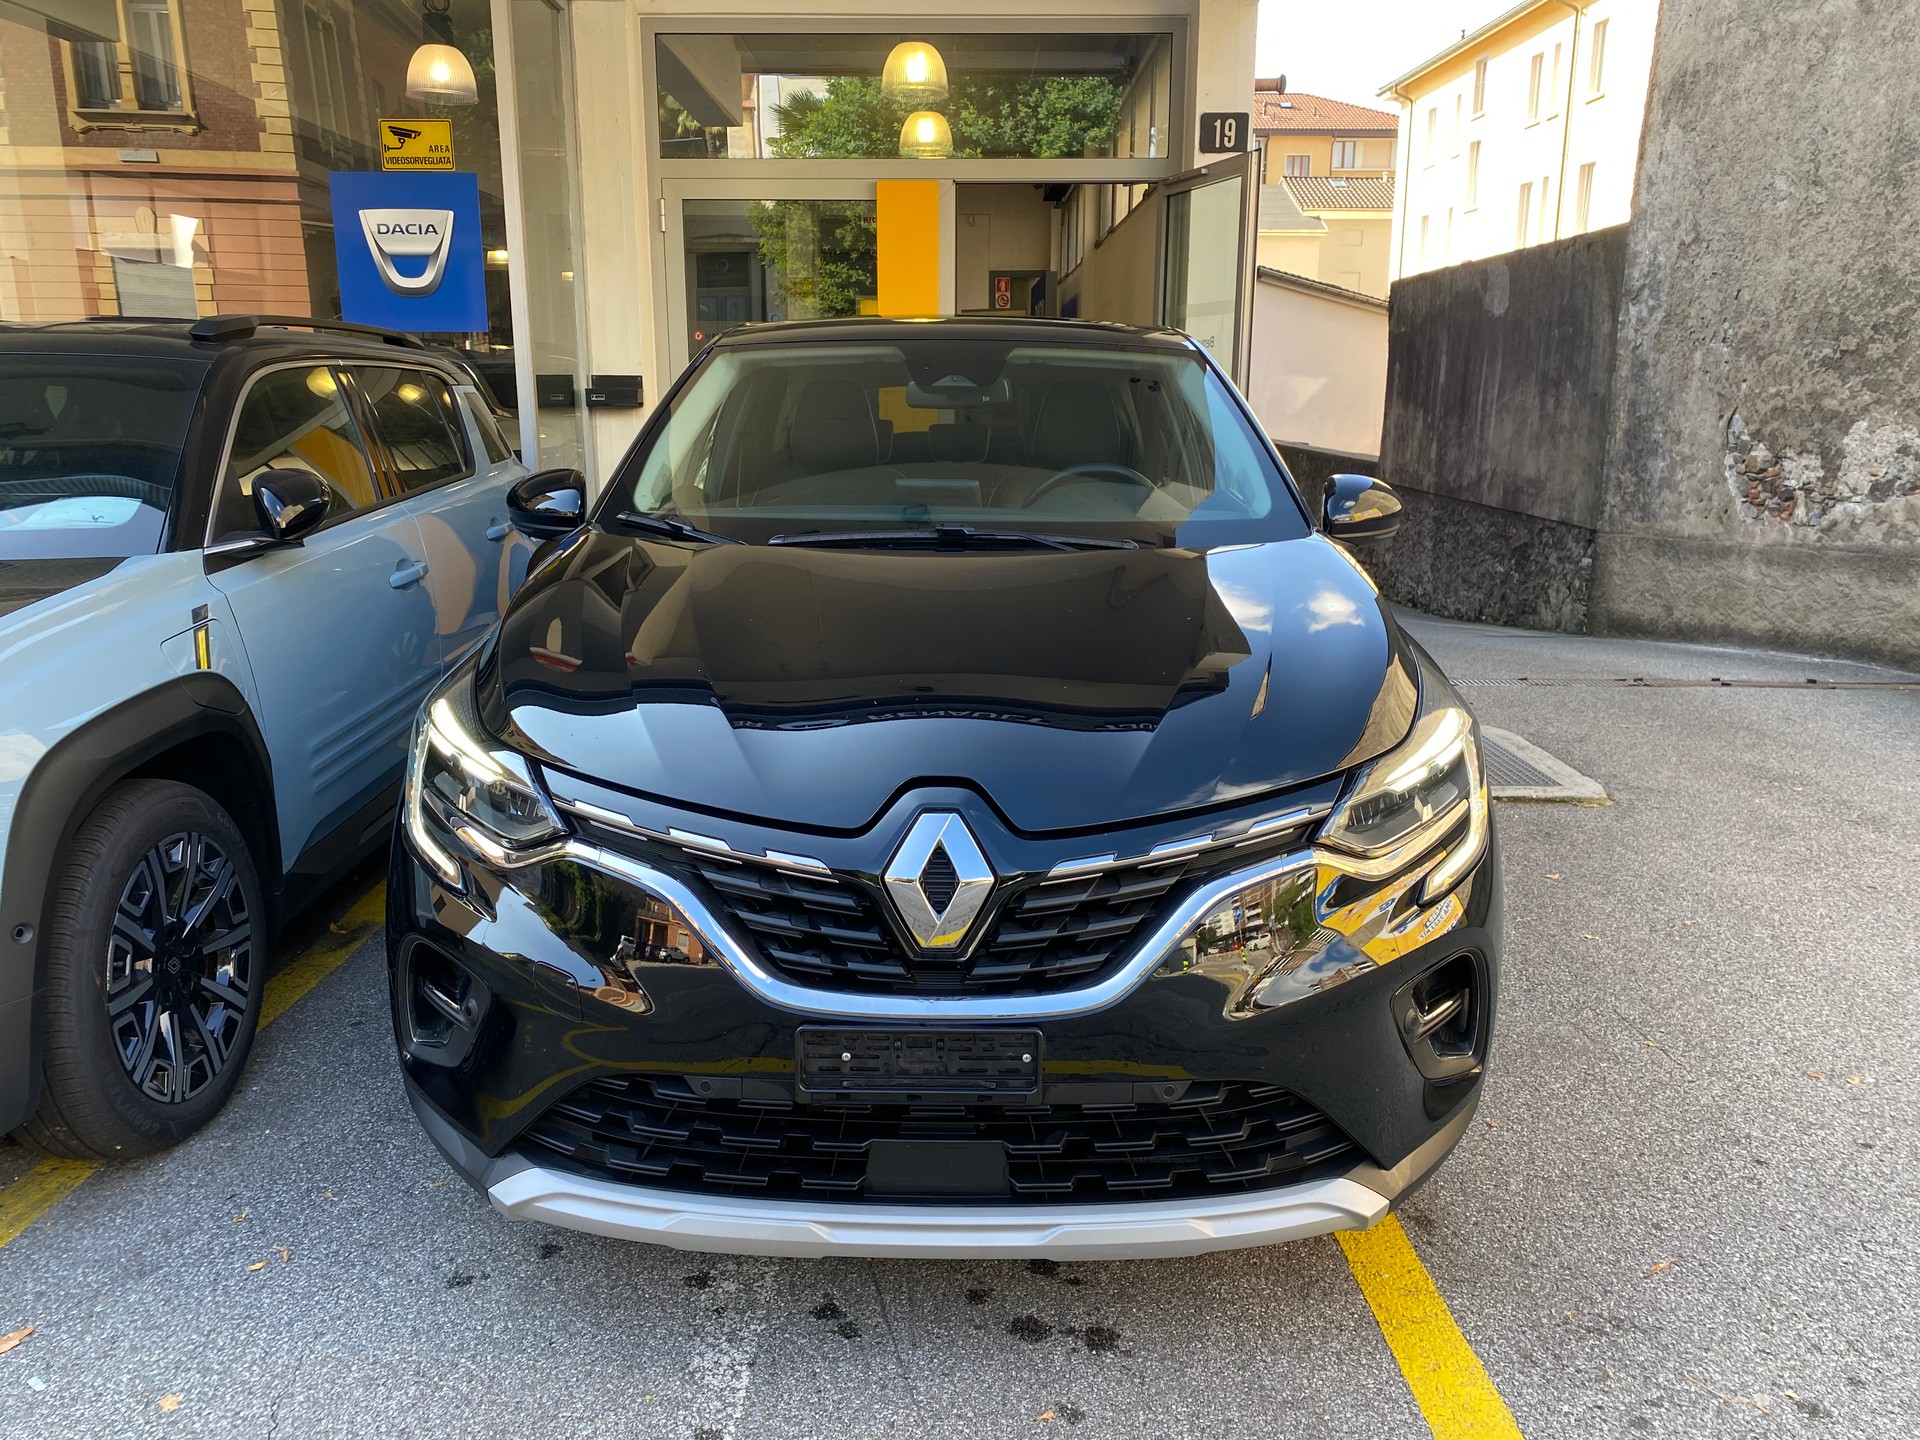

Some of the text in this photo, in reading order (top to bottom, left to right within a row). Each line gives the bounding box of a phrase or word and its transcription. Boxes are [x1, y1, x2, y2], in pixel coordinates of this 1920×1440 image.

[1213, 118, 1237, 149] 19
[428, 144, 451, 153] AREA
[385, 156, 452, 165] VIDEOSORVEGLIATA
[377, 223, 439, 235] DACIA
